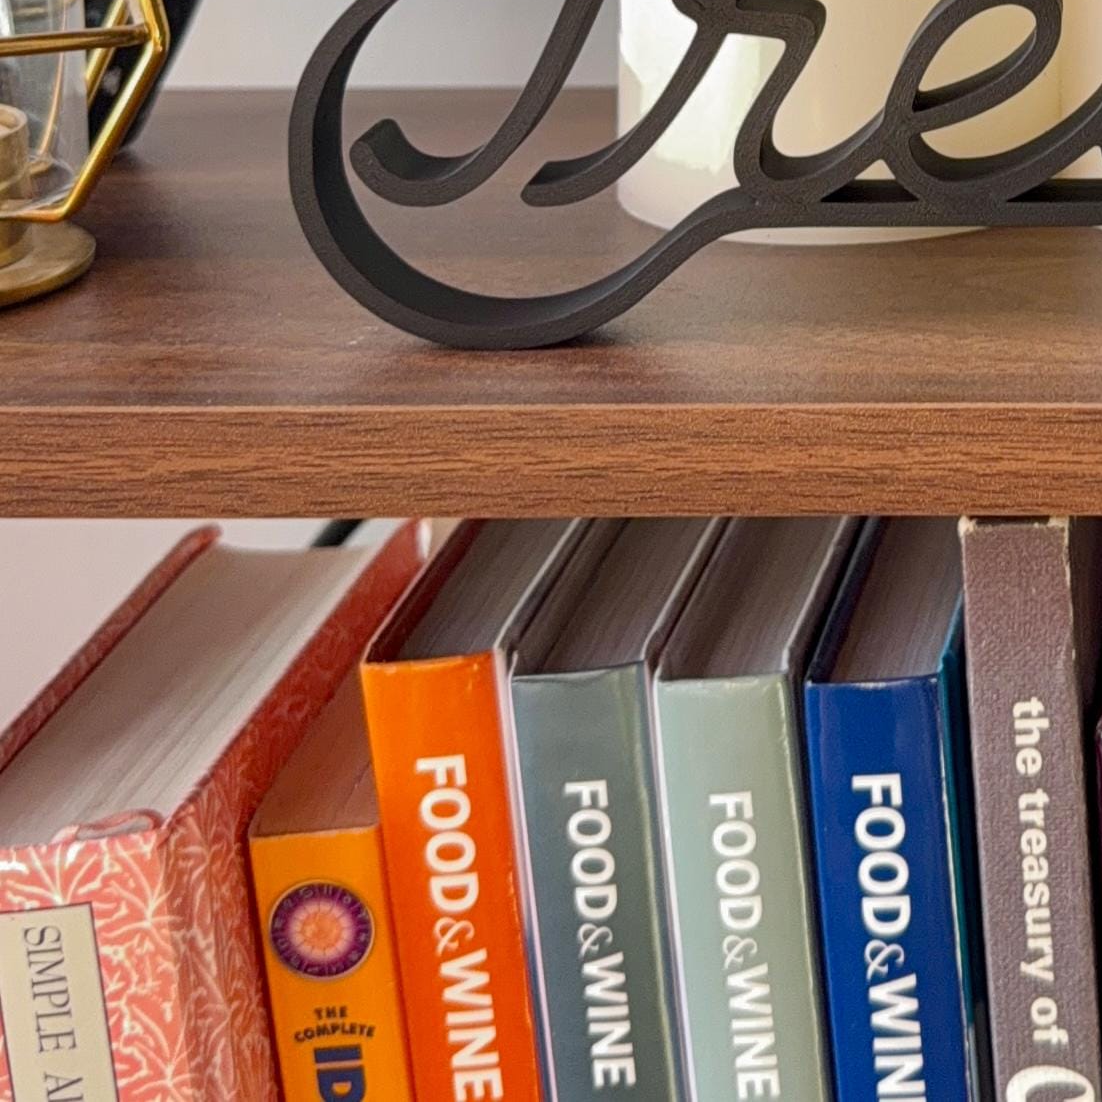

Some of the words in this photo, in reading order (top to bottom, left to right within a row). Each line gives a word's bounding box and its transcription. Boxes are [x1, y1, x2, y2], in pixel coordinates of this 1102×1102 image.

[1012, 696, 1050, 776] the
[1018, 788, 1055, 983] treasury
[851, 773, 927, 1102] FOOD&WIN
[23, 925, 77, 1053] SIMPLE
[314, 1005, 348, 1020] THE
[1030, 996, 1069, 1044] of
[294, 1022, 375, 1043] COMPLETE
[44, 1071, 84, 1102] A
